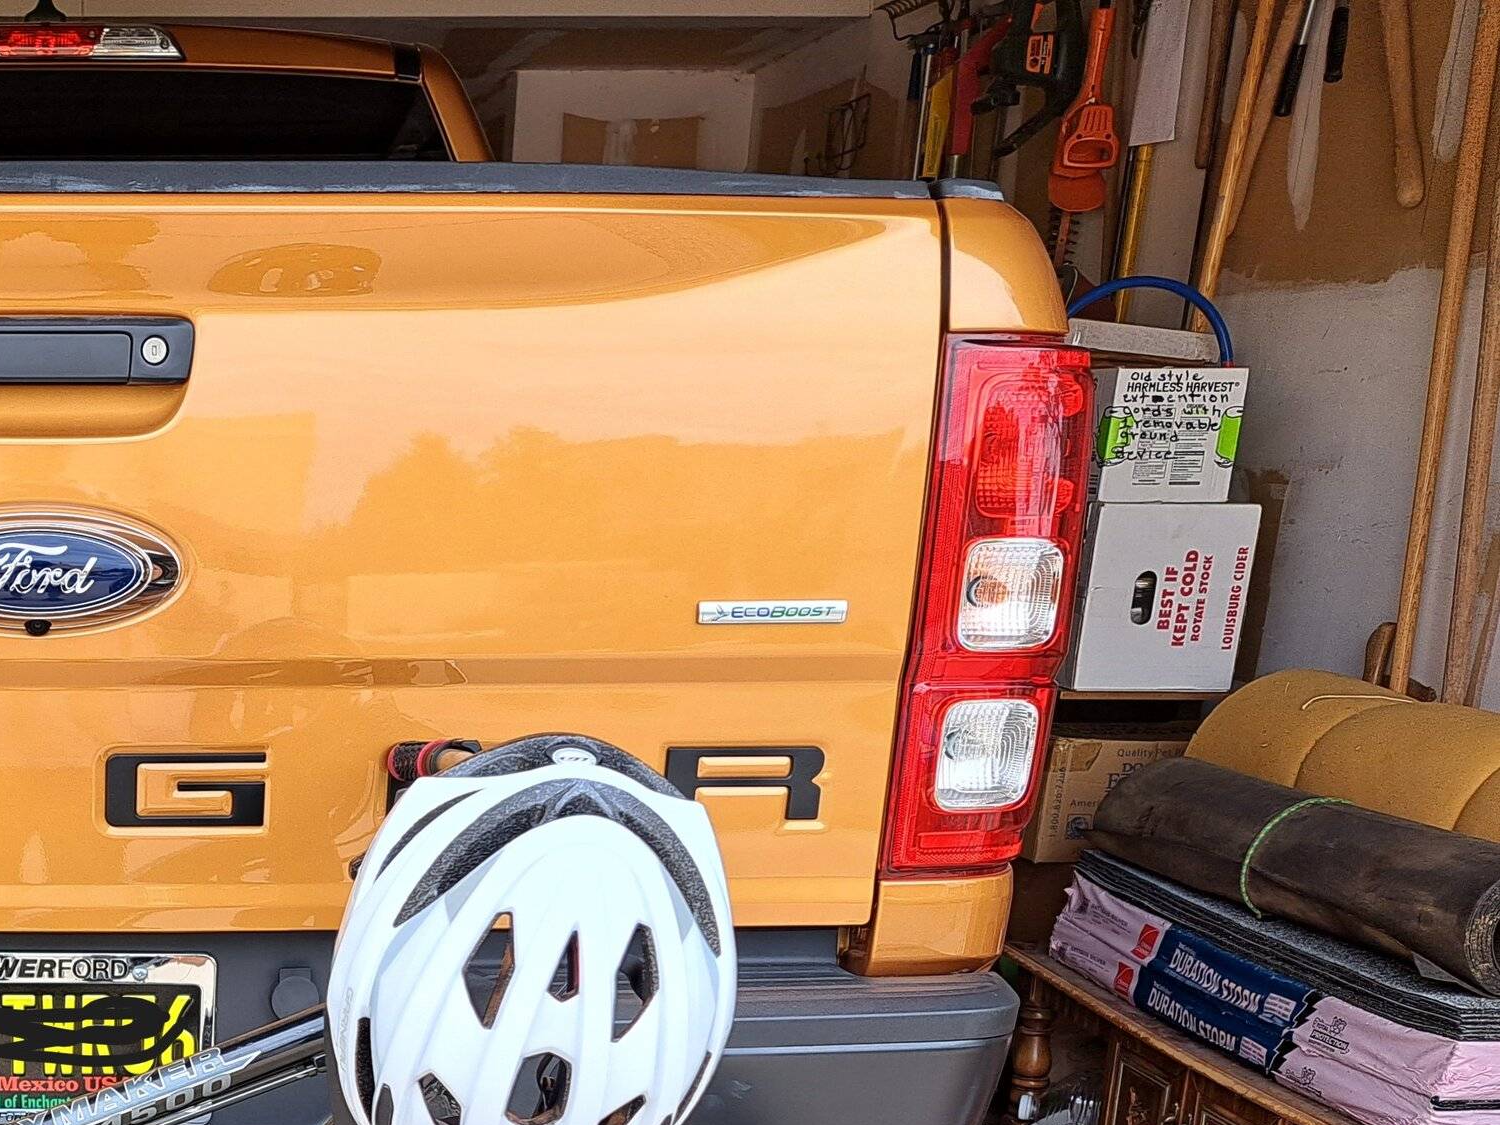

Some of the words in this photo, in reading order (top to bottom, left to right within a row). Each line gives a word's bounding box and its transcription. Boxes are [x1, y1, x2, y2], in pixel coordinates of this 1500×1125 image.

[1131, 372, 1152, 381] Old
[1158, 371, 1204, 385] style
[1127, 382, 1183, 393] HARMLESS
[1183, 405, 1222, 418] with
[1135, 420, 1221, 432] removable
[1120, 431, 1180, 446] ground
[1164, 566, 1179, 582] IF
[1180, 550, 1199, 597] COLD
[1190, 599, 1205, 642] ROTATE
[1199, 555, 1213, 594] STOCK
[1221, 585, 1242, 650] LOUISBURG
[1234, 546, 1250, 581] CIDER
[731, 606, 836, 619] ECOBOOST
[1156, 589, 1175, 630] BEST
[1171, 603, 1190, 646] KEPT
[1117, 749, 1152, 758] Quality
[1070, 800, 1096, 808] Amer
[1169, 947, 1223, 995] DURATION
[1222, 978, 1261, 1014] STORM
[1147, 986, 1198, 1034] DURATION
[1197, 1020, 1236, 1052] STORM
[84, 1076, 129, 1092] US
[6, 1094, 18, 1108] of
